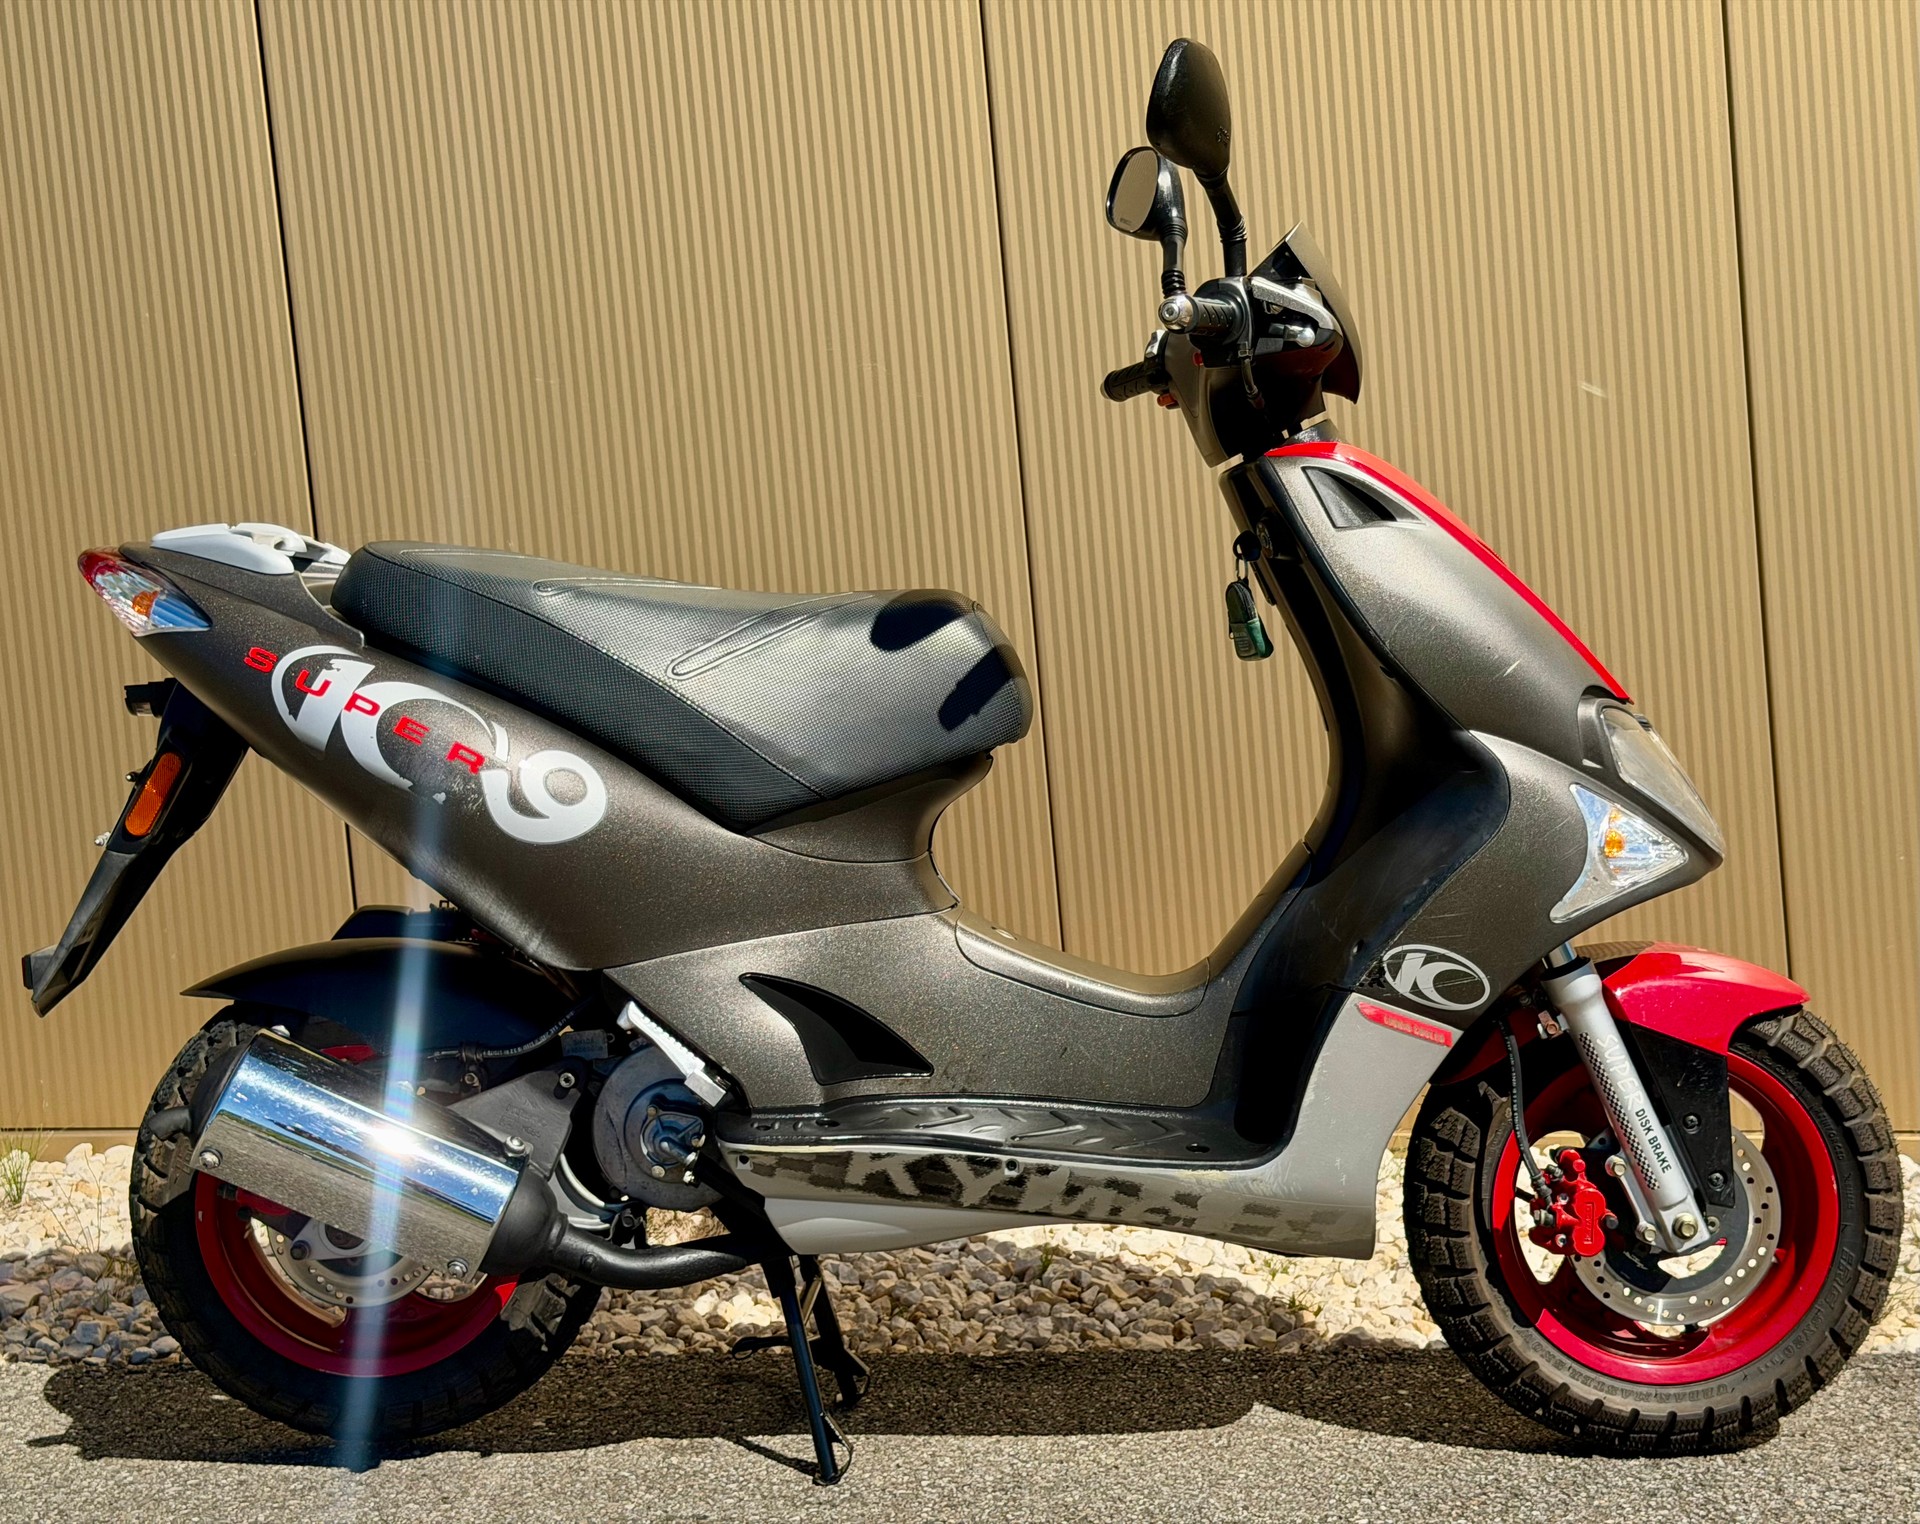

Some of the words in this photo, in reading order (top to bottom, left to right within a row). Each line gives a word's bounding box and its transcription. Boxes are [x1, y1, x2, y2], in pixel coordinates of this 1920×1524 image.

[243, 646, 485, 775] SUPER
[1597, 1034, 1644, 1111] SUPER
[1635, 1108, 1654, 1136] DISK
[1648, 1135, 1672, 1174] BRAKE
